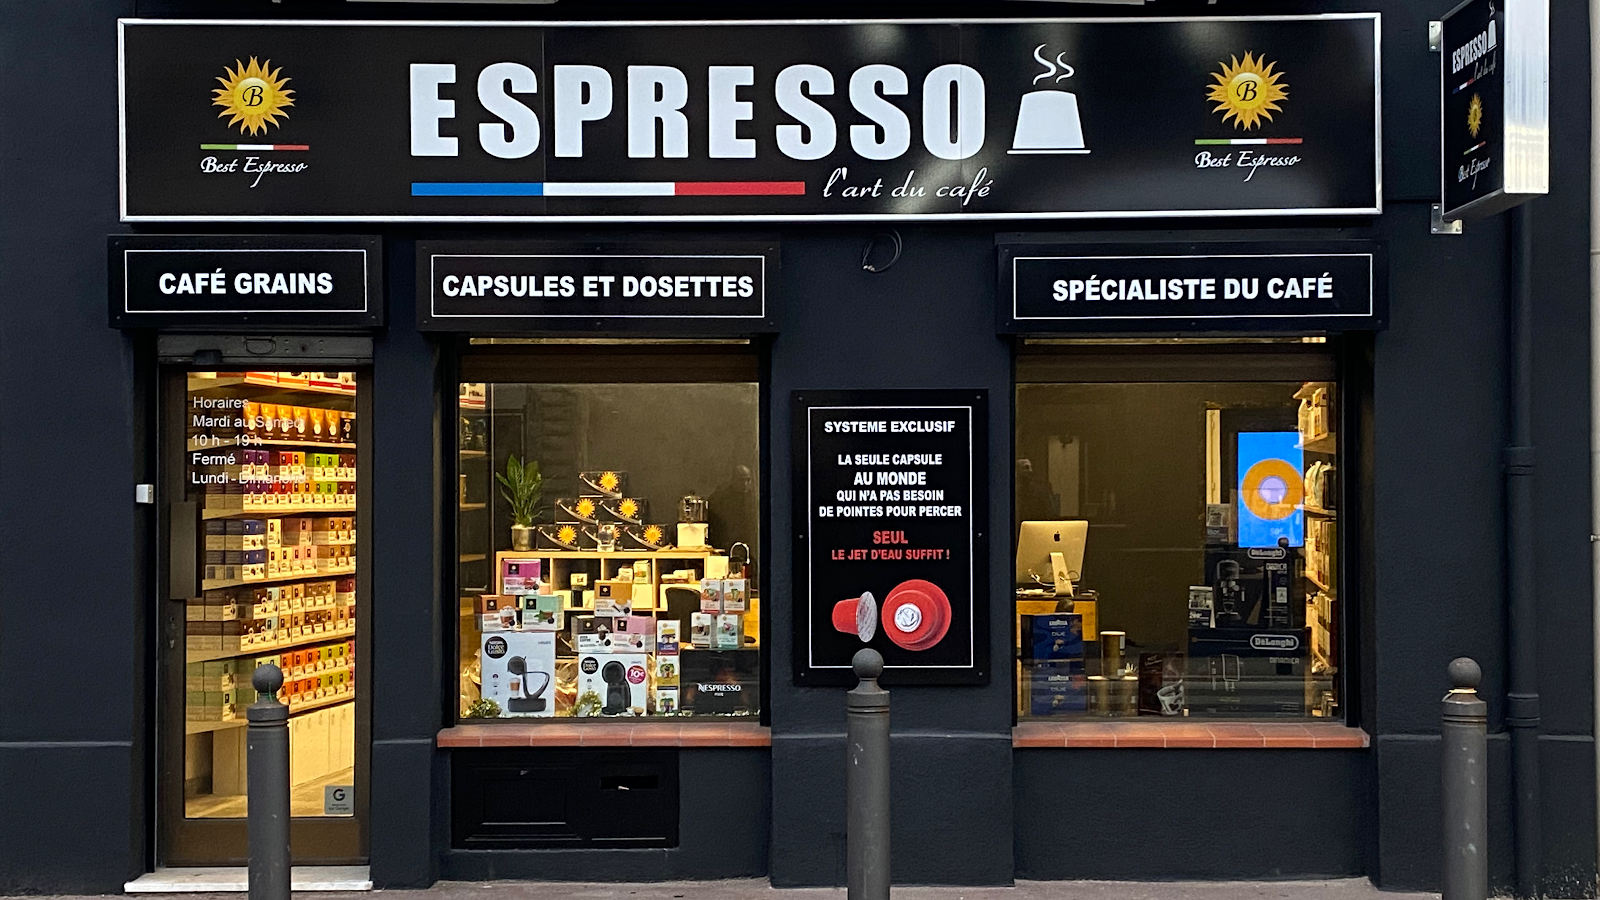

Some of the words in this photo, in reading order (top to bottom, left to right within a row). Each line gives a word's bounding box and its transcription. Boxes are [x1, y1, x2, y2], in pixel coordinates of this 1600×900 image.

[1452, 31, 1487, 75] ESPRESSO
[409, 62, 987, 162] ESPRESSO
[200, 157, 239, 174] Best
[243, 157, 309, 189] Espresso
[1195, 151, 1232, 169] Best
[1236, 151, 1303, 183] Espresso
[823, 166, 884, 198] l'art
[891, 169, 927, 198] du
[935, 167, 994, 206] café
[158, 268, 227, 296] CAFÉ
[233, 272, 334, 296] GRAINS
[442, 274, 576, 299] CAPSULES
[582, 275, 616, 299] ET
[623, 275, 754, 299] DOSETTES
[1052, 274, 1217, 302] SPÉCIALISTE
[1224, 277, 1259, 301] DU
[1266, 271, 1334, 300] CAFÉ
[193, 396, 249, 409] Horaires
[193, 414, 231, 428] Mardi
[234, 418, 249, 428] au
[824, 421, 887, 433] SYSTEME
[890, 420, 956, 433] EXCLUSIF
[192, 434, 208, 446] 10
[211, 434, 220, 446] h
[234, 434, 250, 446] 19
[254, 434, 263, 446] h
[192, 452, 236, 466] Fermé
[837, 454, 853, 466] LA
[854, 454, 890, 466] SEULE
[892, 454, 943, 466] CAPSULE
[192, 471, 229, 485] Lundi
[853, 472, 873, 486] AU
[876, 471, 927, 486] MONDE
[836, 490, 857, 502] QUI
[858, 490, 878, 502] N'A
[879, 490, 901, 502] PAS
[902, 490, 944, 502] BESOIN
[818, 506, 834, 518] DE
[836, 506, 884, 518] POINTES
[885, 506, 917, 517] POUR
[918, 505, 962, 517] PERCER
[872, 530, 909, 545] SEUL
[831, 549, 845, 561] LE
[847, 549, 869, 561] JET
[870, 549, 903, 560] D'EAU
[905, 549, 944, 560] SUFFIT
[696, 682, 742, 693] NESPRESSO
